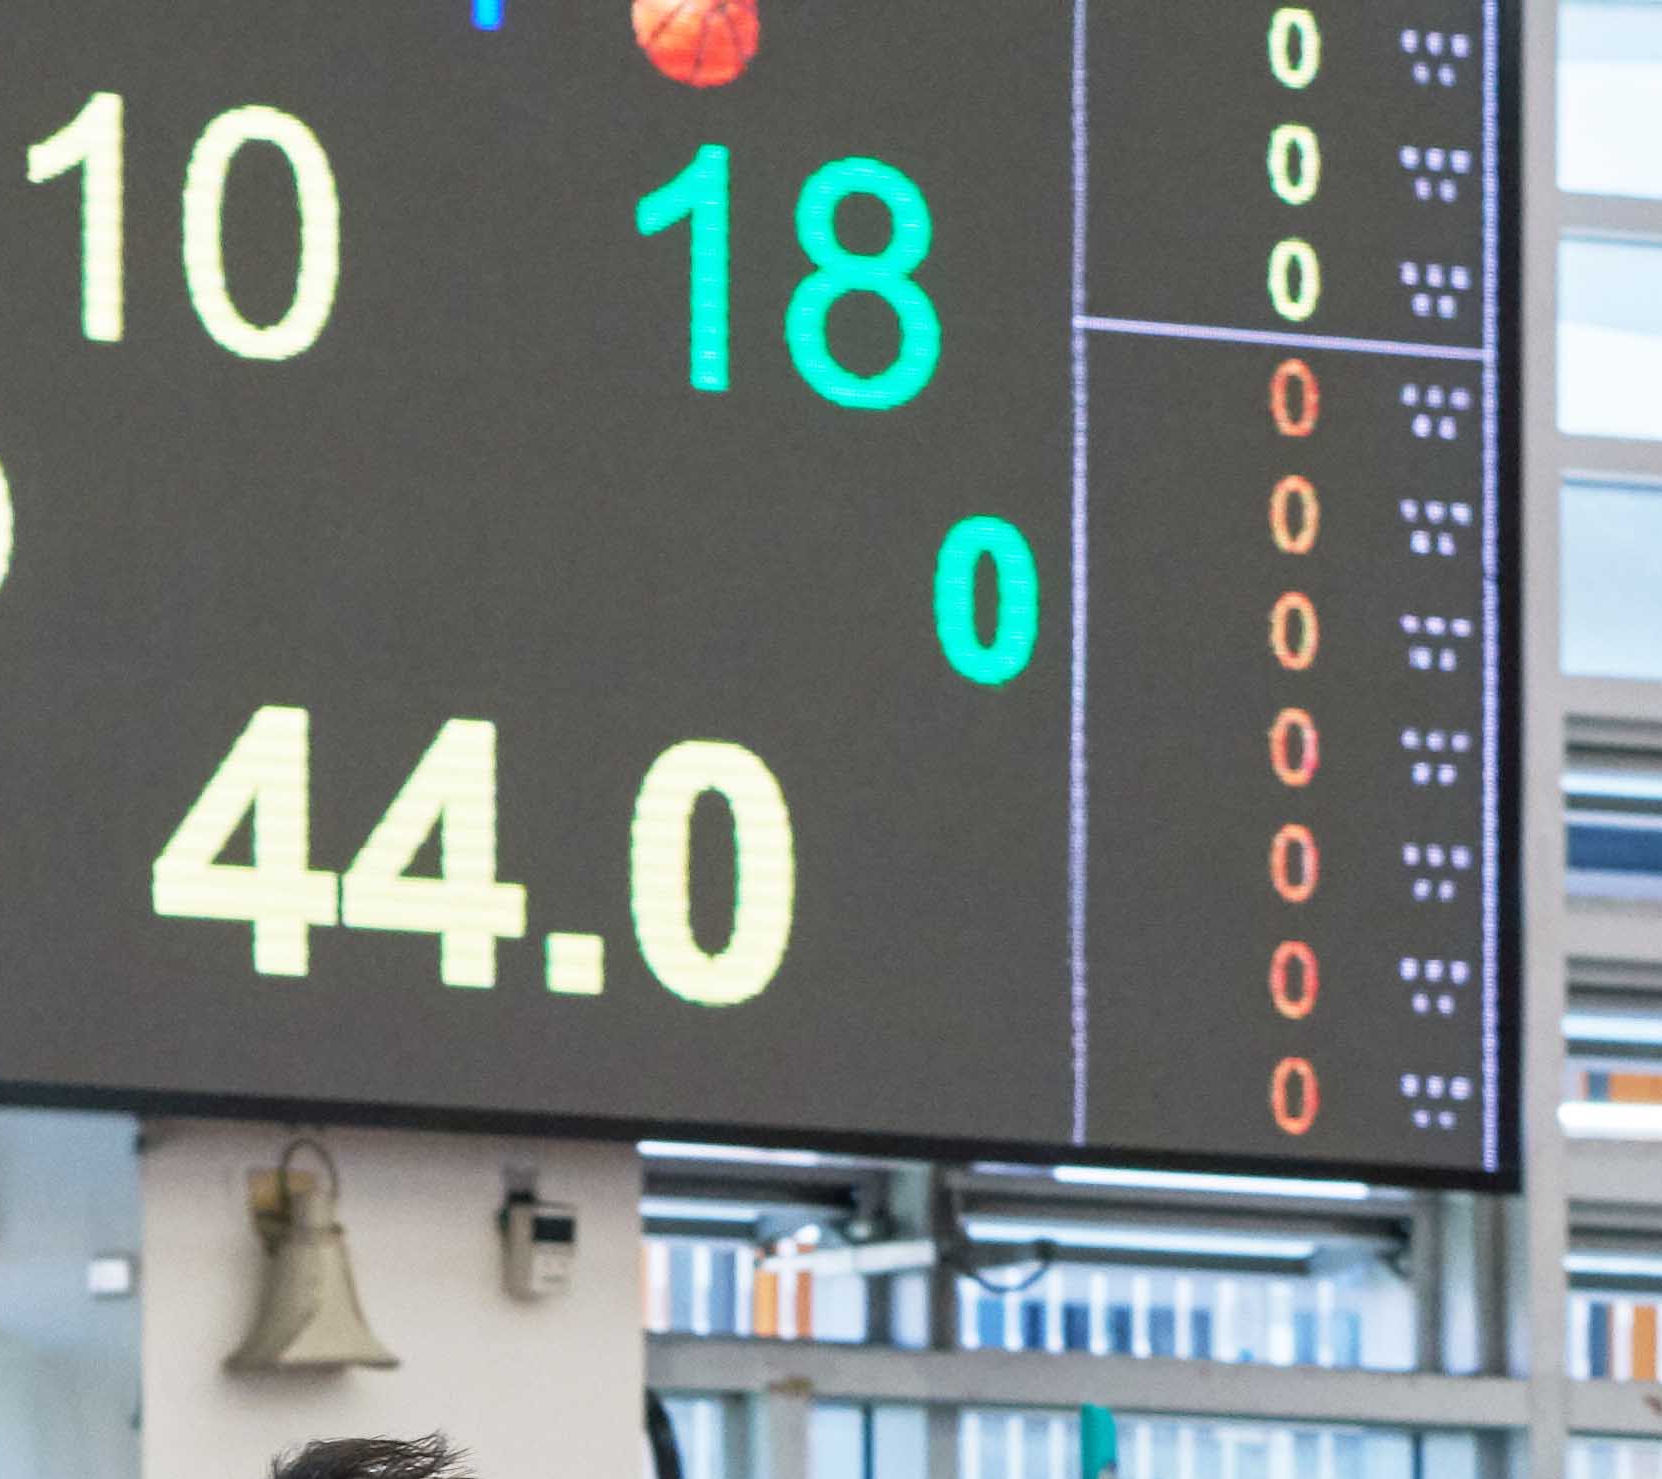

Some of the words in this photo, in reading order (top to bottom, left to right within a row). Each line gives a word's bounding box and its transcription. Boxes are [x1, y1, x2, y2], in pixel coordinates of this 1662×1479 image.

[1268, 8, 1321, 88] 0
[1267, 124, 1320, 205] 0
[27, 92, 340, 361] 10
[636, 144, 941, 410] 18
[1268, 238, 1320, 322] 0
[1271, 359, 1319, 436] 0
[1270, 475, 1319, 554] 0
[933, 516, 1039, 685] 0
[1270, 592, 1319, 670] 0
[1269, 708, 1319, 786] 0
[152, 705, 796, 1007] 44.0
[1271, 824, 1319, 902] 0
[1270, 941, 1319, 1019] 0
[1272, 1057, 1319, 1135] 0
